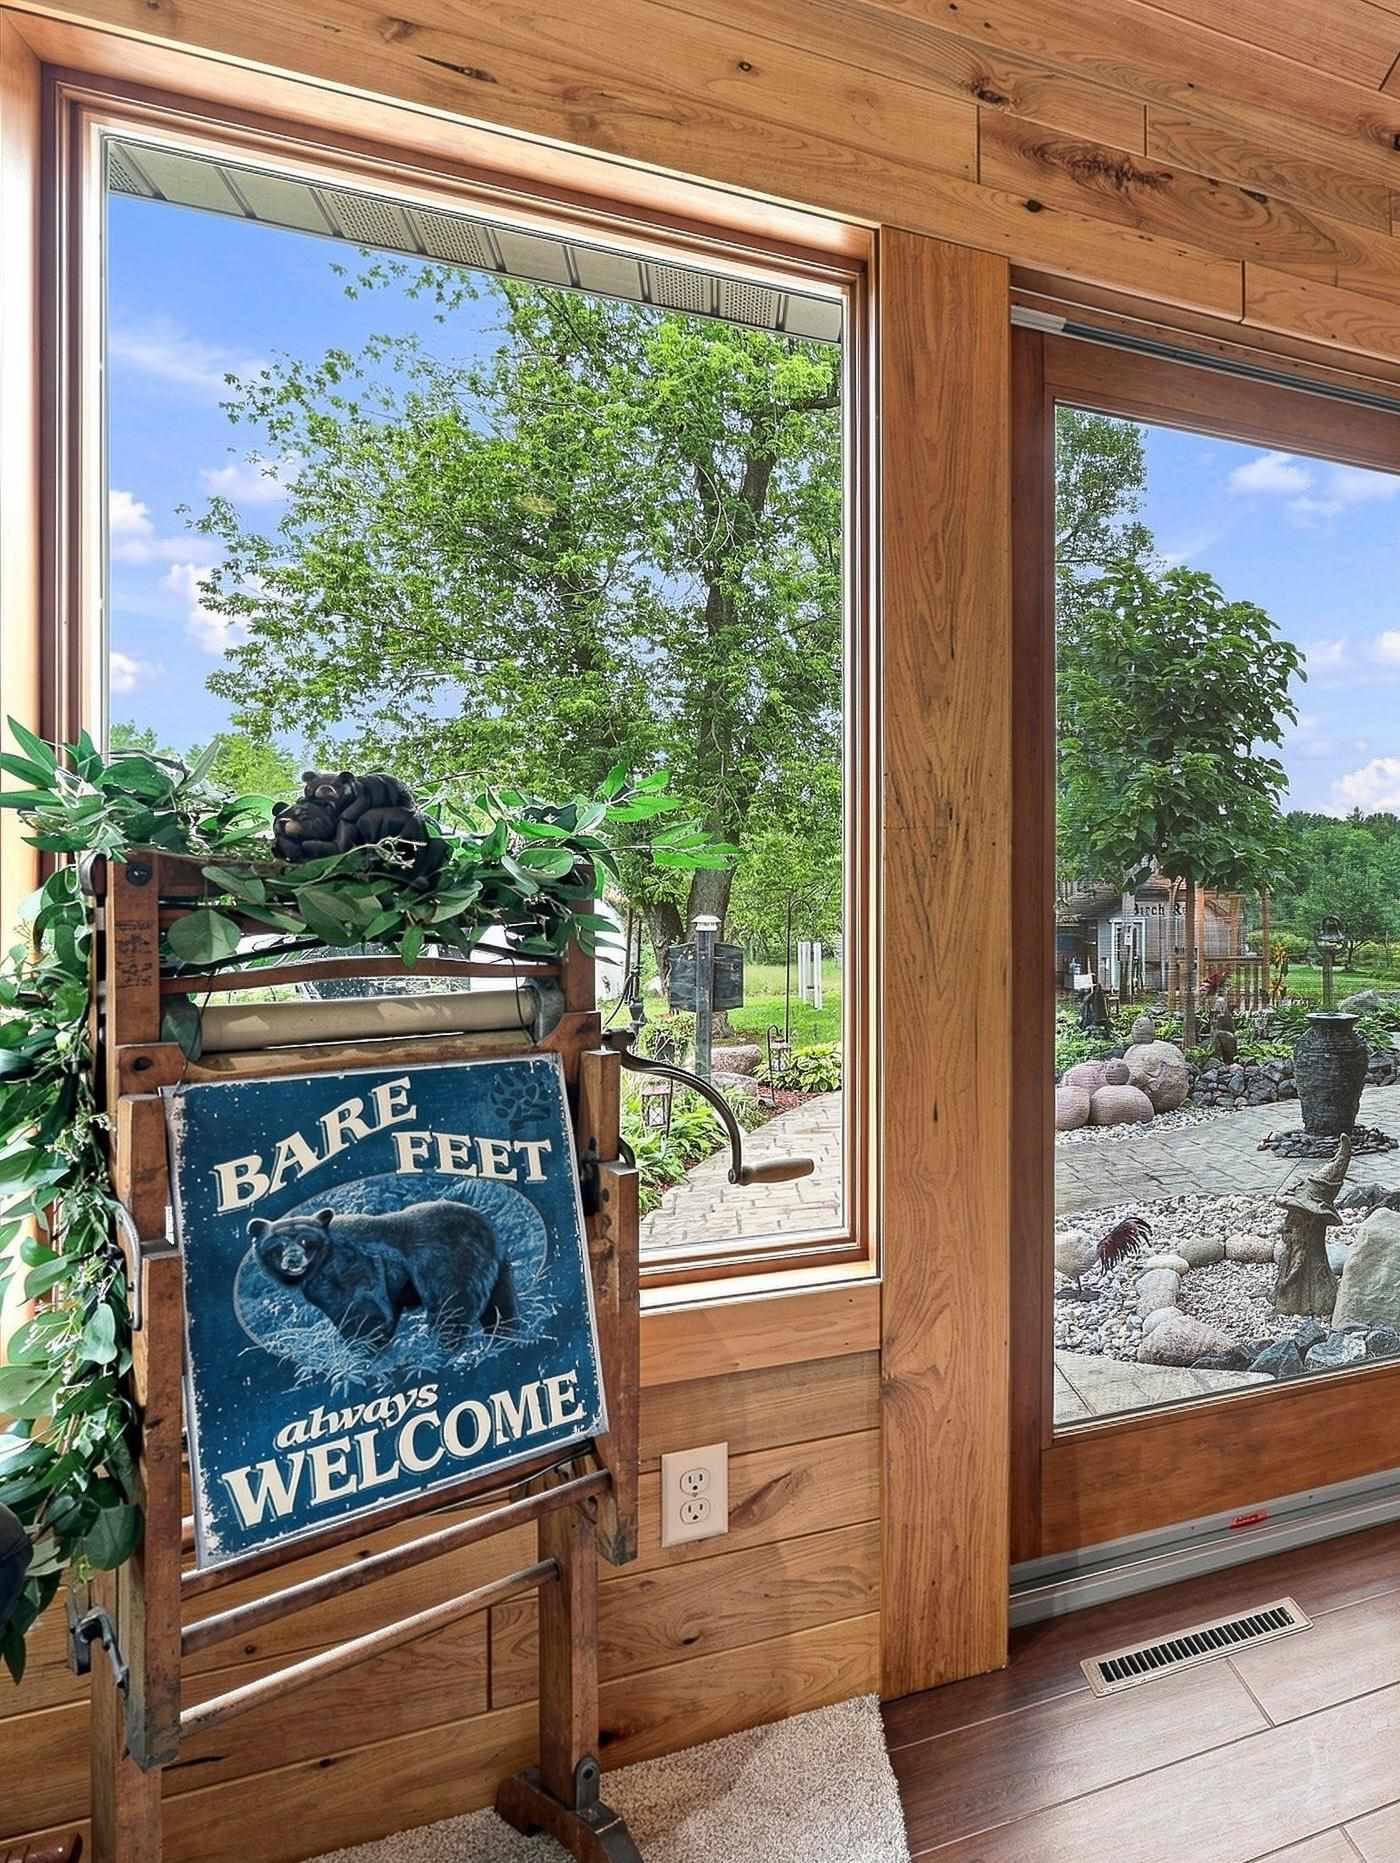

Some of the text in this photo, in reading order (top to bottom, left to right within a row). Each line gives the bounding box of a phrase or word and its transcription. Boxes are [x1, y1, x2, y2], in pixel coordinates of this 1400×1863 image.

[212, 1077, 416, 1214] BARE
[393, 1131, 552, 1182] FEET
[222, 1370, 586, 1530] WELCOME
[273, 1382, 439, 1451] always
